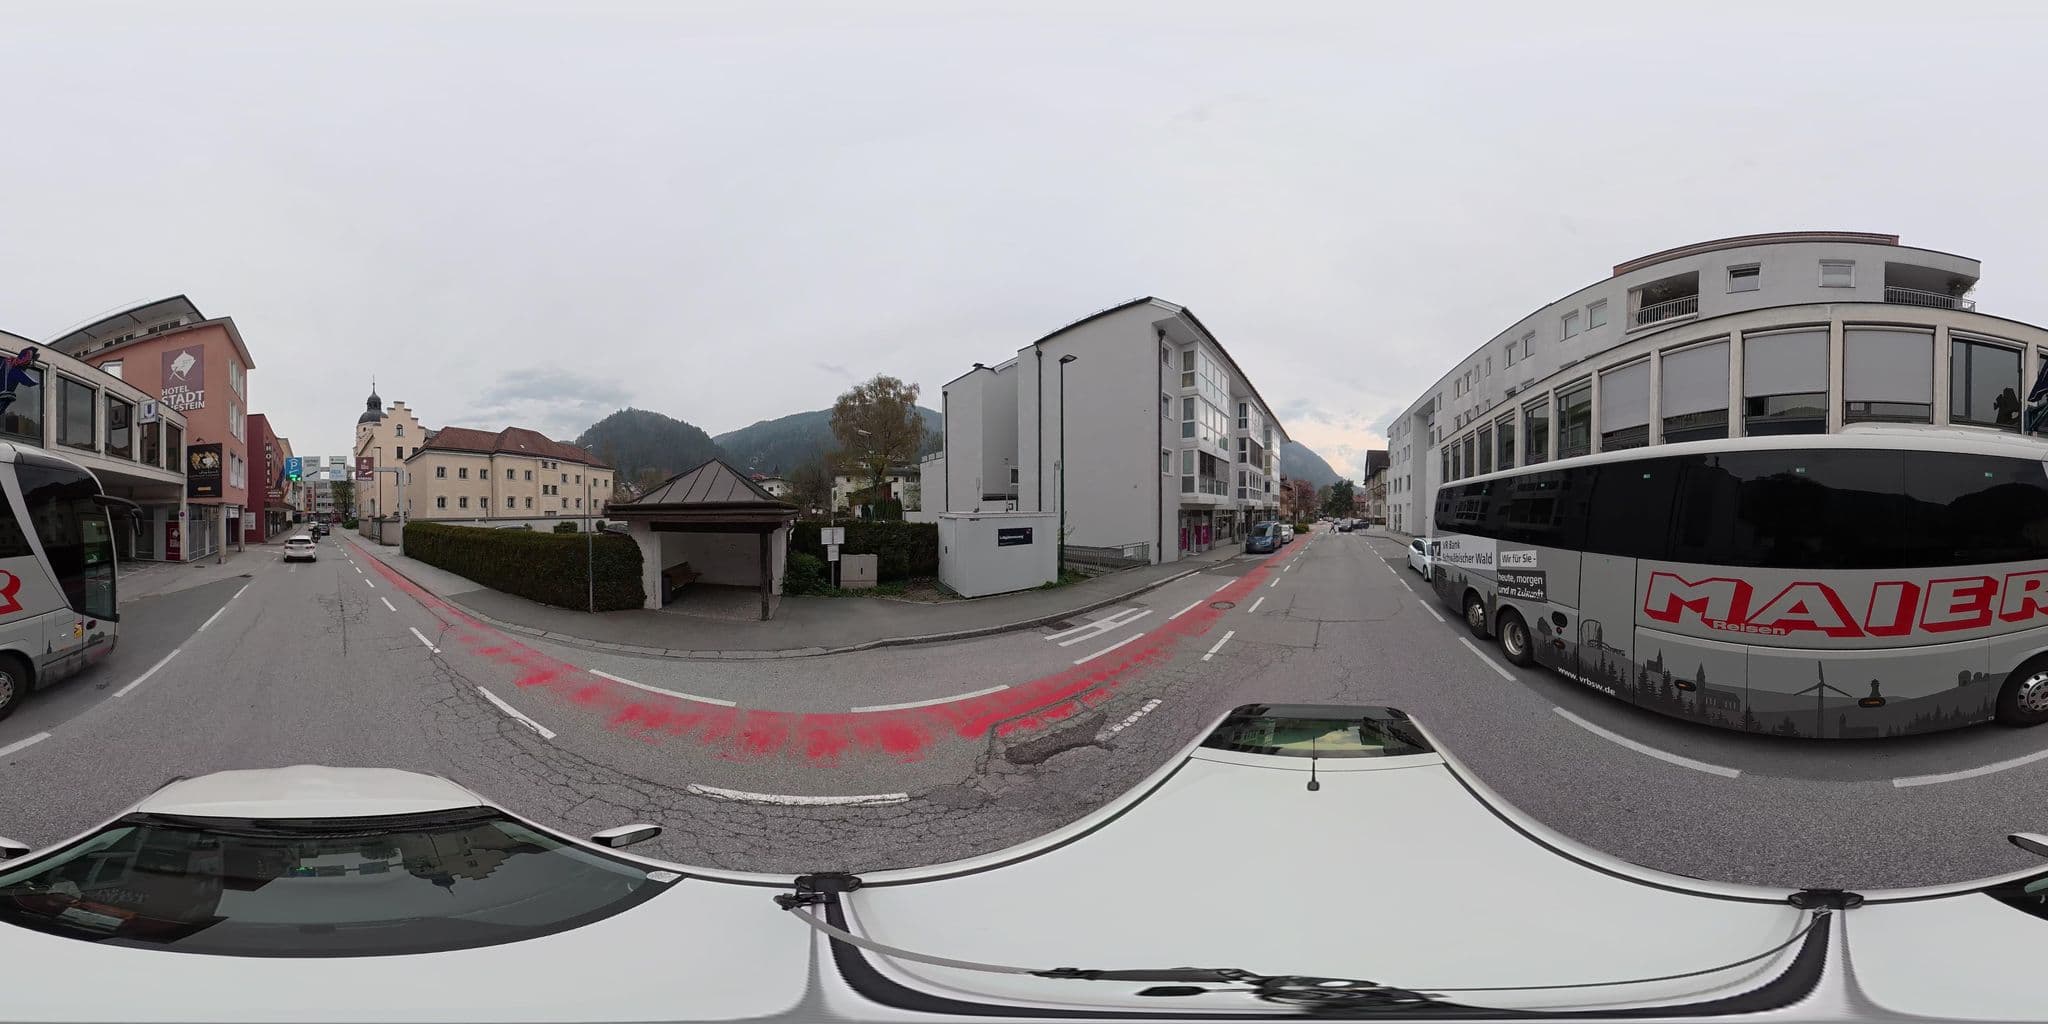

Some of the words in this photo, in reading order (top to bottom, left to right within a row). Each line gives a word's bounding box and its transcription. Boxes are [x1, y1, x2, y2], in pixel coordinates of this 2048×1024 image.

[162, 385, 189, 396] HOTEL
[162, 391, 205, 406] STADT
[1475, 551, 1493, 565] Wald
[1501, 553, 1511, 563] Wir
[1512, 553, 1521, 563] für
[1522, 553, 1533, 563] Sie
[1498, 571, 1516, 584] heute,
[1516, 575, 1543, 587] morgen
[1498, 586, 1510, 595] und
[1517, 587, 1544, 599] Zukunft
[1712, 620, 1786, 636] Reisen
